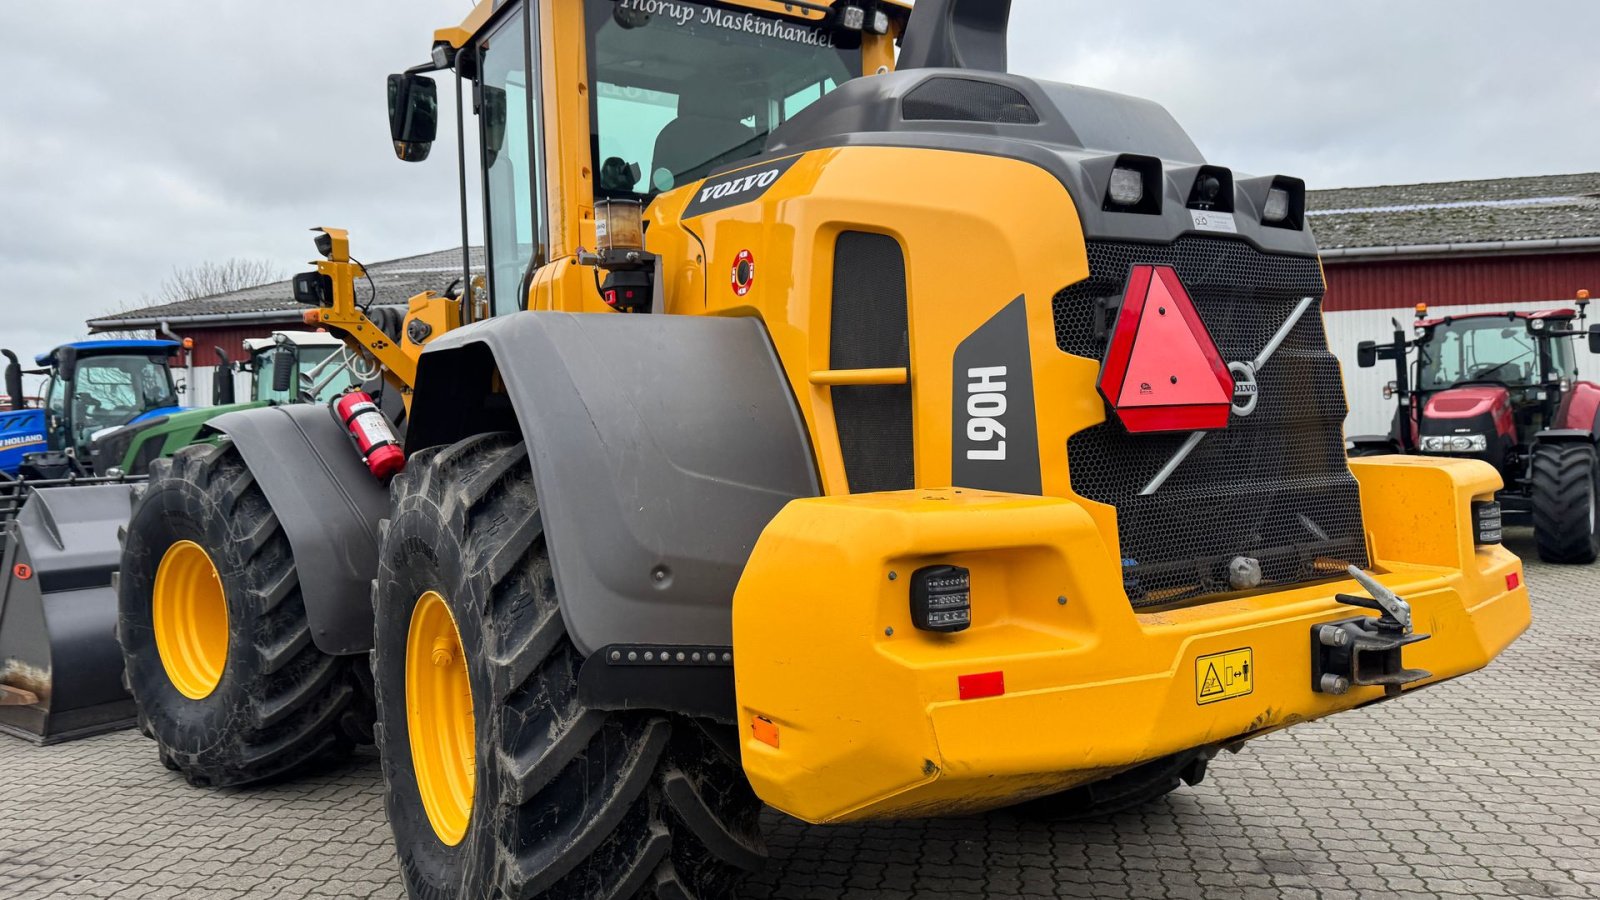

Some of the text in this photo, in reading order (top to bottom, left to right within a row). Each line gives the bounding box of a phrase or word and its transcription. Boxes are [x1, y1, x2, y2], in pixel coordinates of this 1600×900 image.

[701, 7, 835, 48] Maskinhandel
[700, 169, 779, 202] VOLVO
[1235, 384, 1257, 392] OLVO
[967, 366, 1007, 460] L90H
[5, 434, 43, 446] HOLLAND
